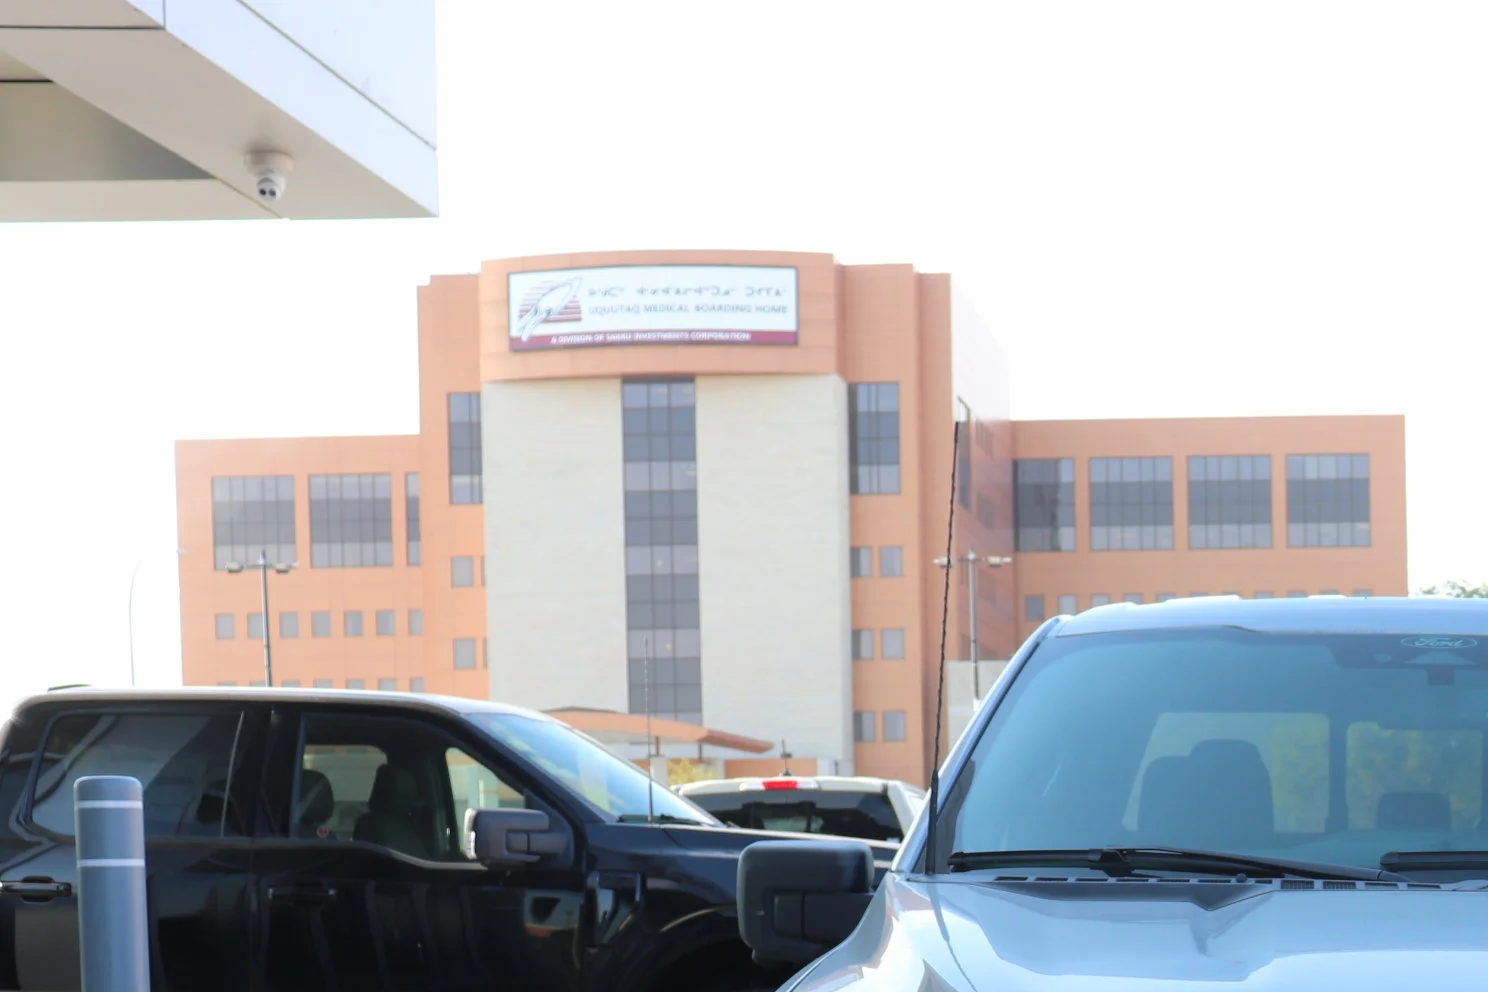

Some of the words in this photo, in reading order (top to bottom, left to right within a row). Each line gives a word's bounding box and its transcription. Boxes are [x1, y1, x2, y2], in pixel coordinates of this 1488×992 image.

[643, 303, 690, 313] MEDICAL
[694, 303, 752, 313] BOARDING
[755, 304, 788, 314] HOME
[1415, 636, 1463, 648] Ford
